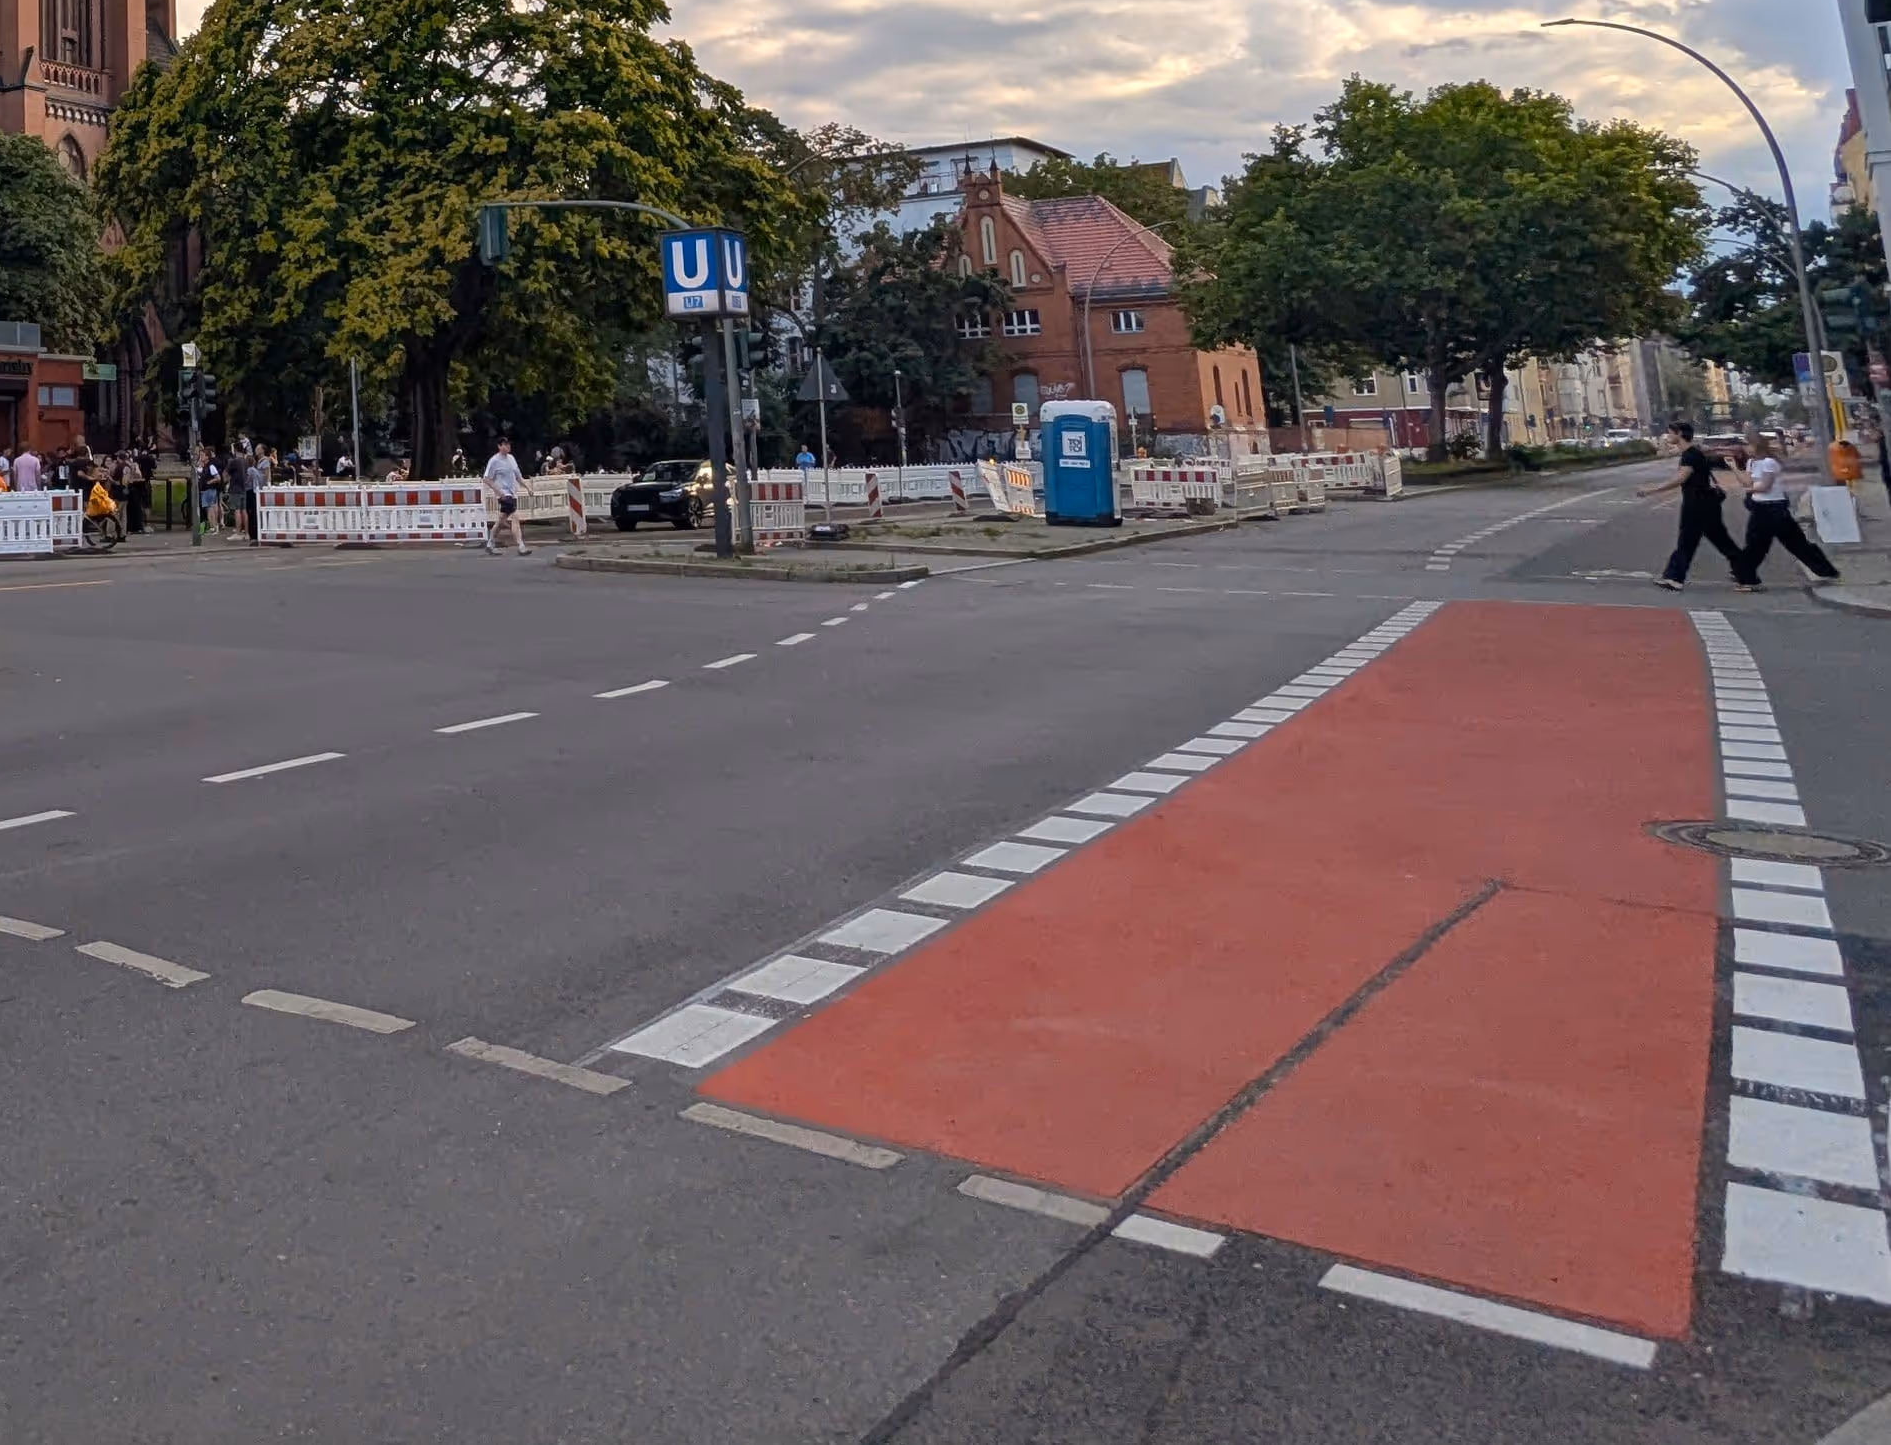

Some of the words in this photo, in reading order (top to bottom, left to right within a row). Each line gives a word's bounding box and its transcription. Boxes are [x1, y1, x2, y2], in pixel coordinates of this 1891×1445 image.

[672, 238, 709, 288] U
[724, 239, 743, 289] U
[685, 297, 702, 308] U7
